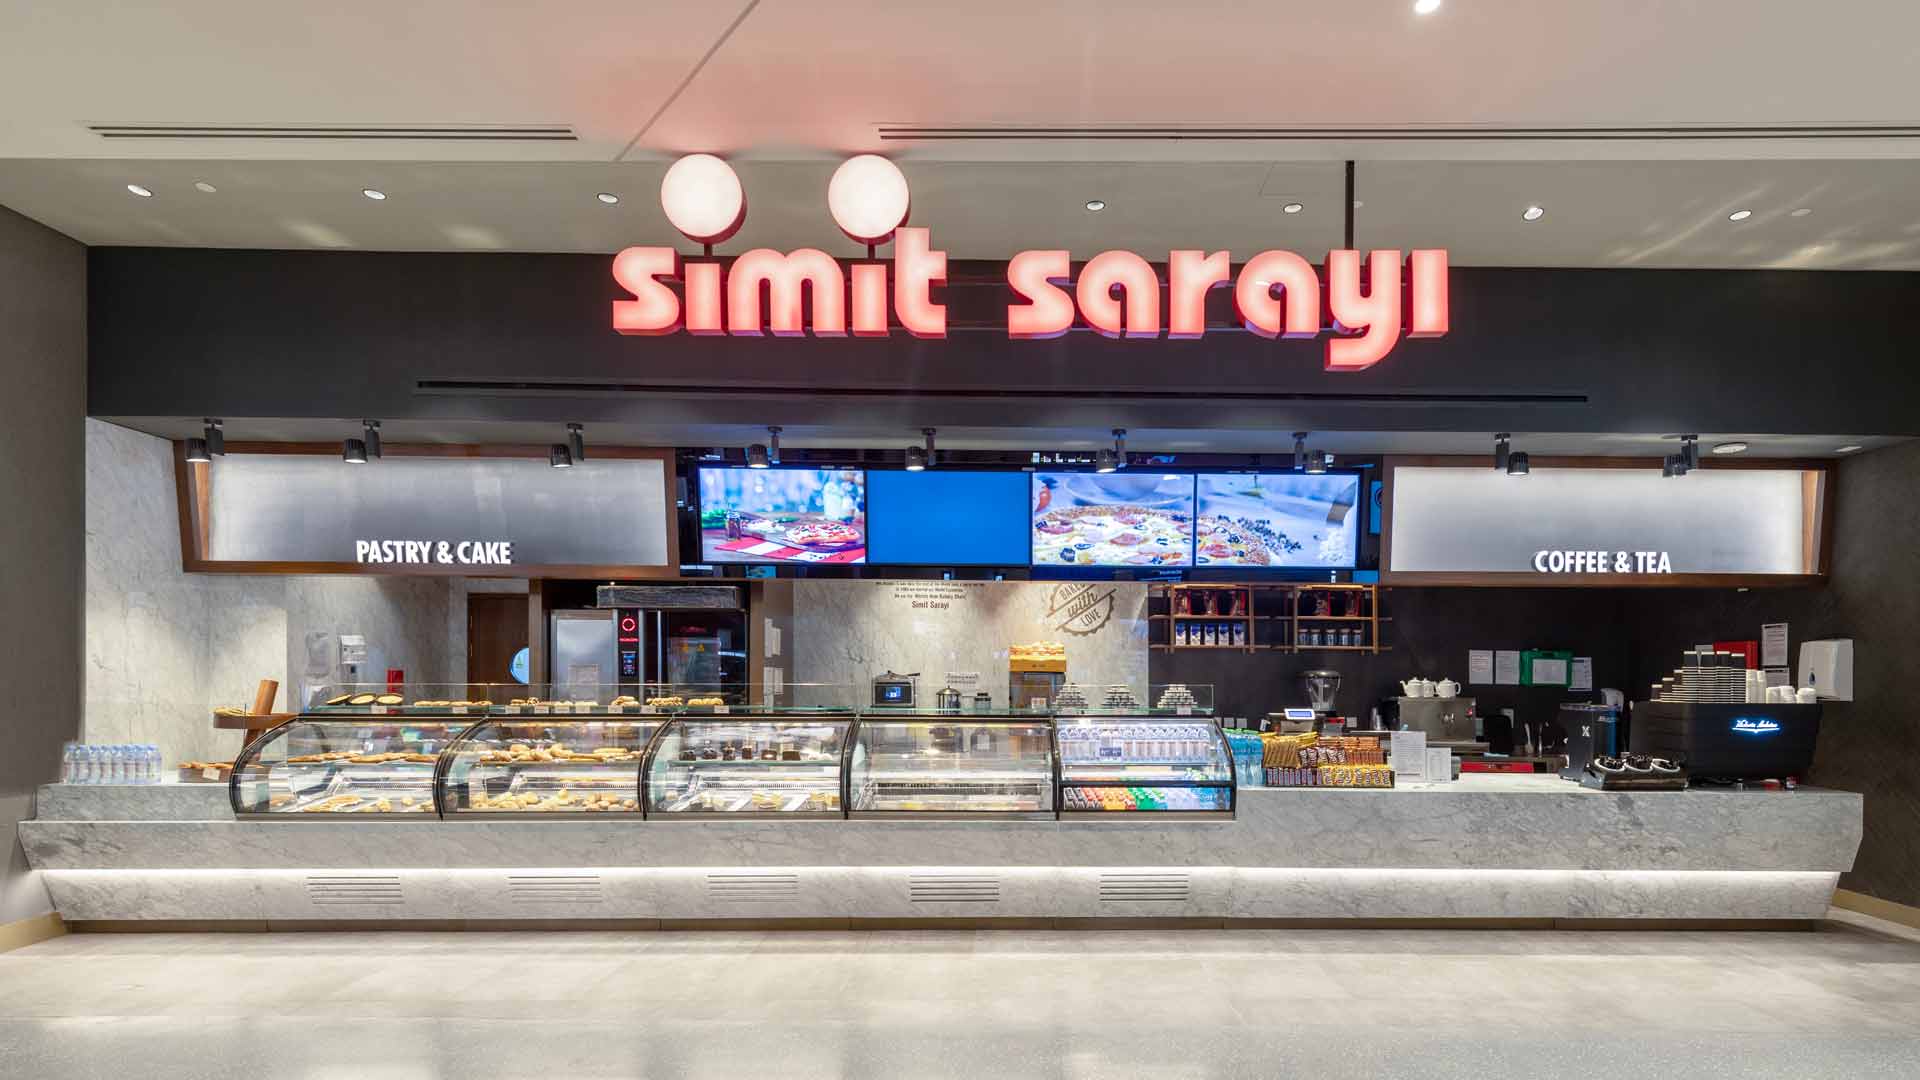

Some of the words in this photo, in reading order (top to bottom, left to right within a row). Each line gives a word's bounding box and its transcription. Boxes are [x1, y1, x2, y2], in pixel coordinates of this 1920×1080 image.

[612, 153, 947, 339] simit
[356, 540, 432, 563] PASTRY
[437, 541, 453, 563] &
[457, 542, 512, 564] CAKE
[1535, 551, 1608, 573] COFFEE
[1614, 551, 1631, 573] &
[1635, 551, 1672, 573] TEA
[911, 601, 928, 609] Simit
[1067, 591, 1098, 617] with
[1080, 608, 1101, 626] LOVE
